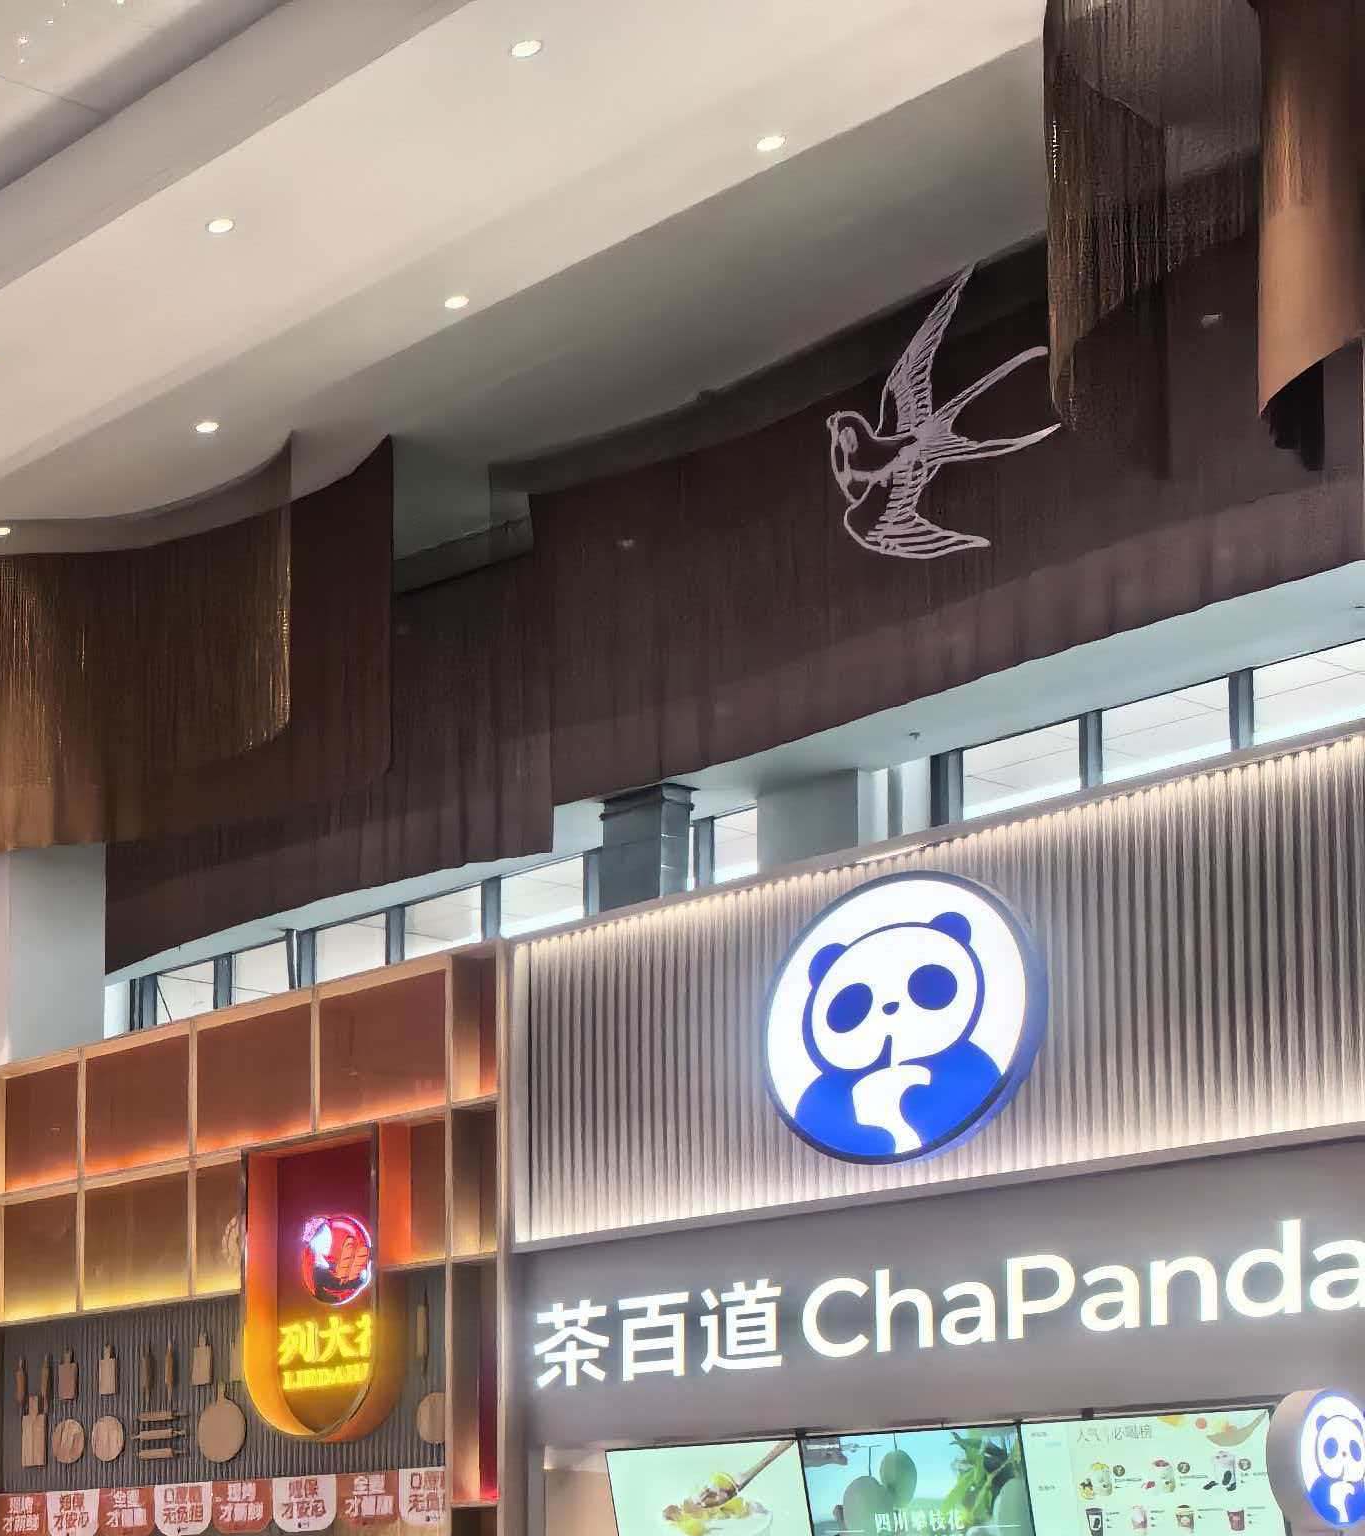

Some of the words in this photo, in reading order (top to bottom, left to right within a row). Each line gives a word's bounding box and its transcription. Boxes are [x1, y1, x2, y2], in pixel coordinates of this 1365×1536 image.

[534, 1279, 783, 1389] 茶百道
[800, 1219, 1365, 1359] ChaPanda
